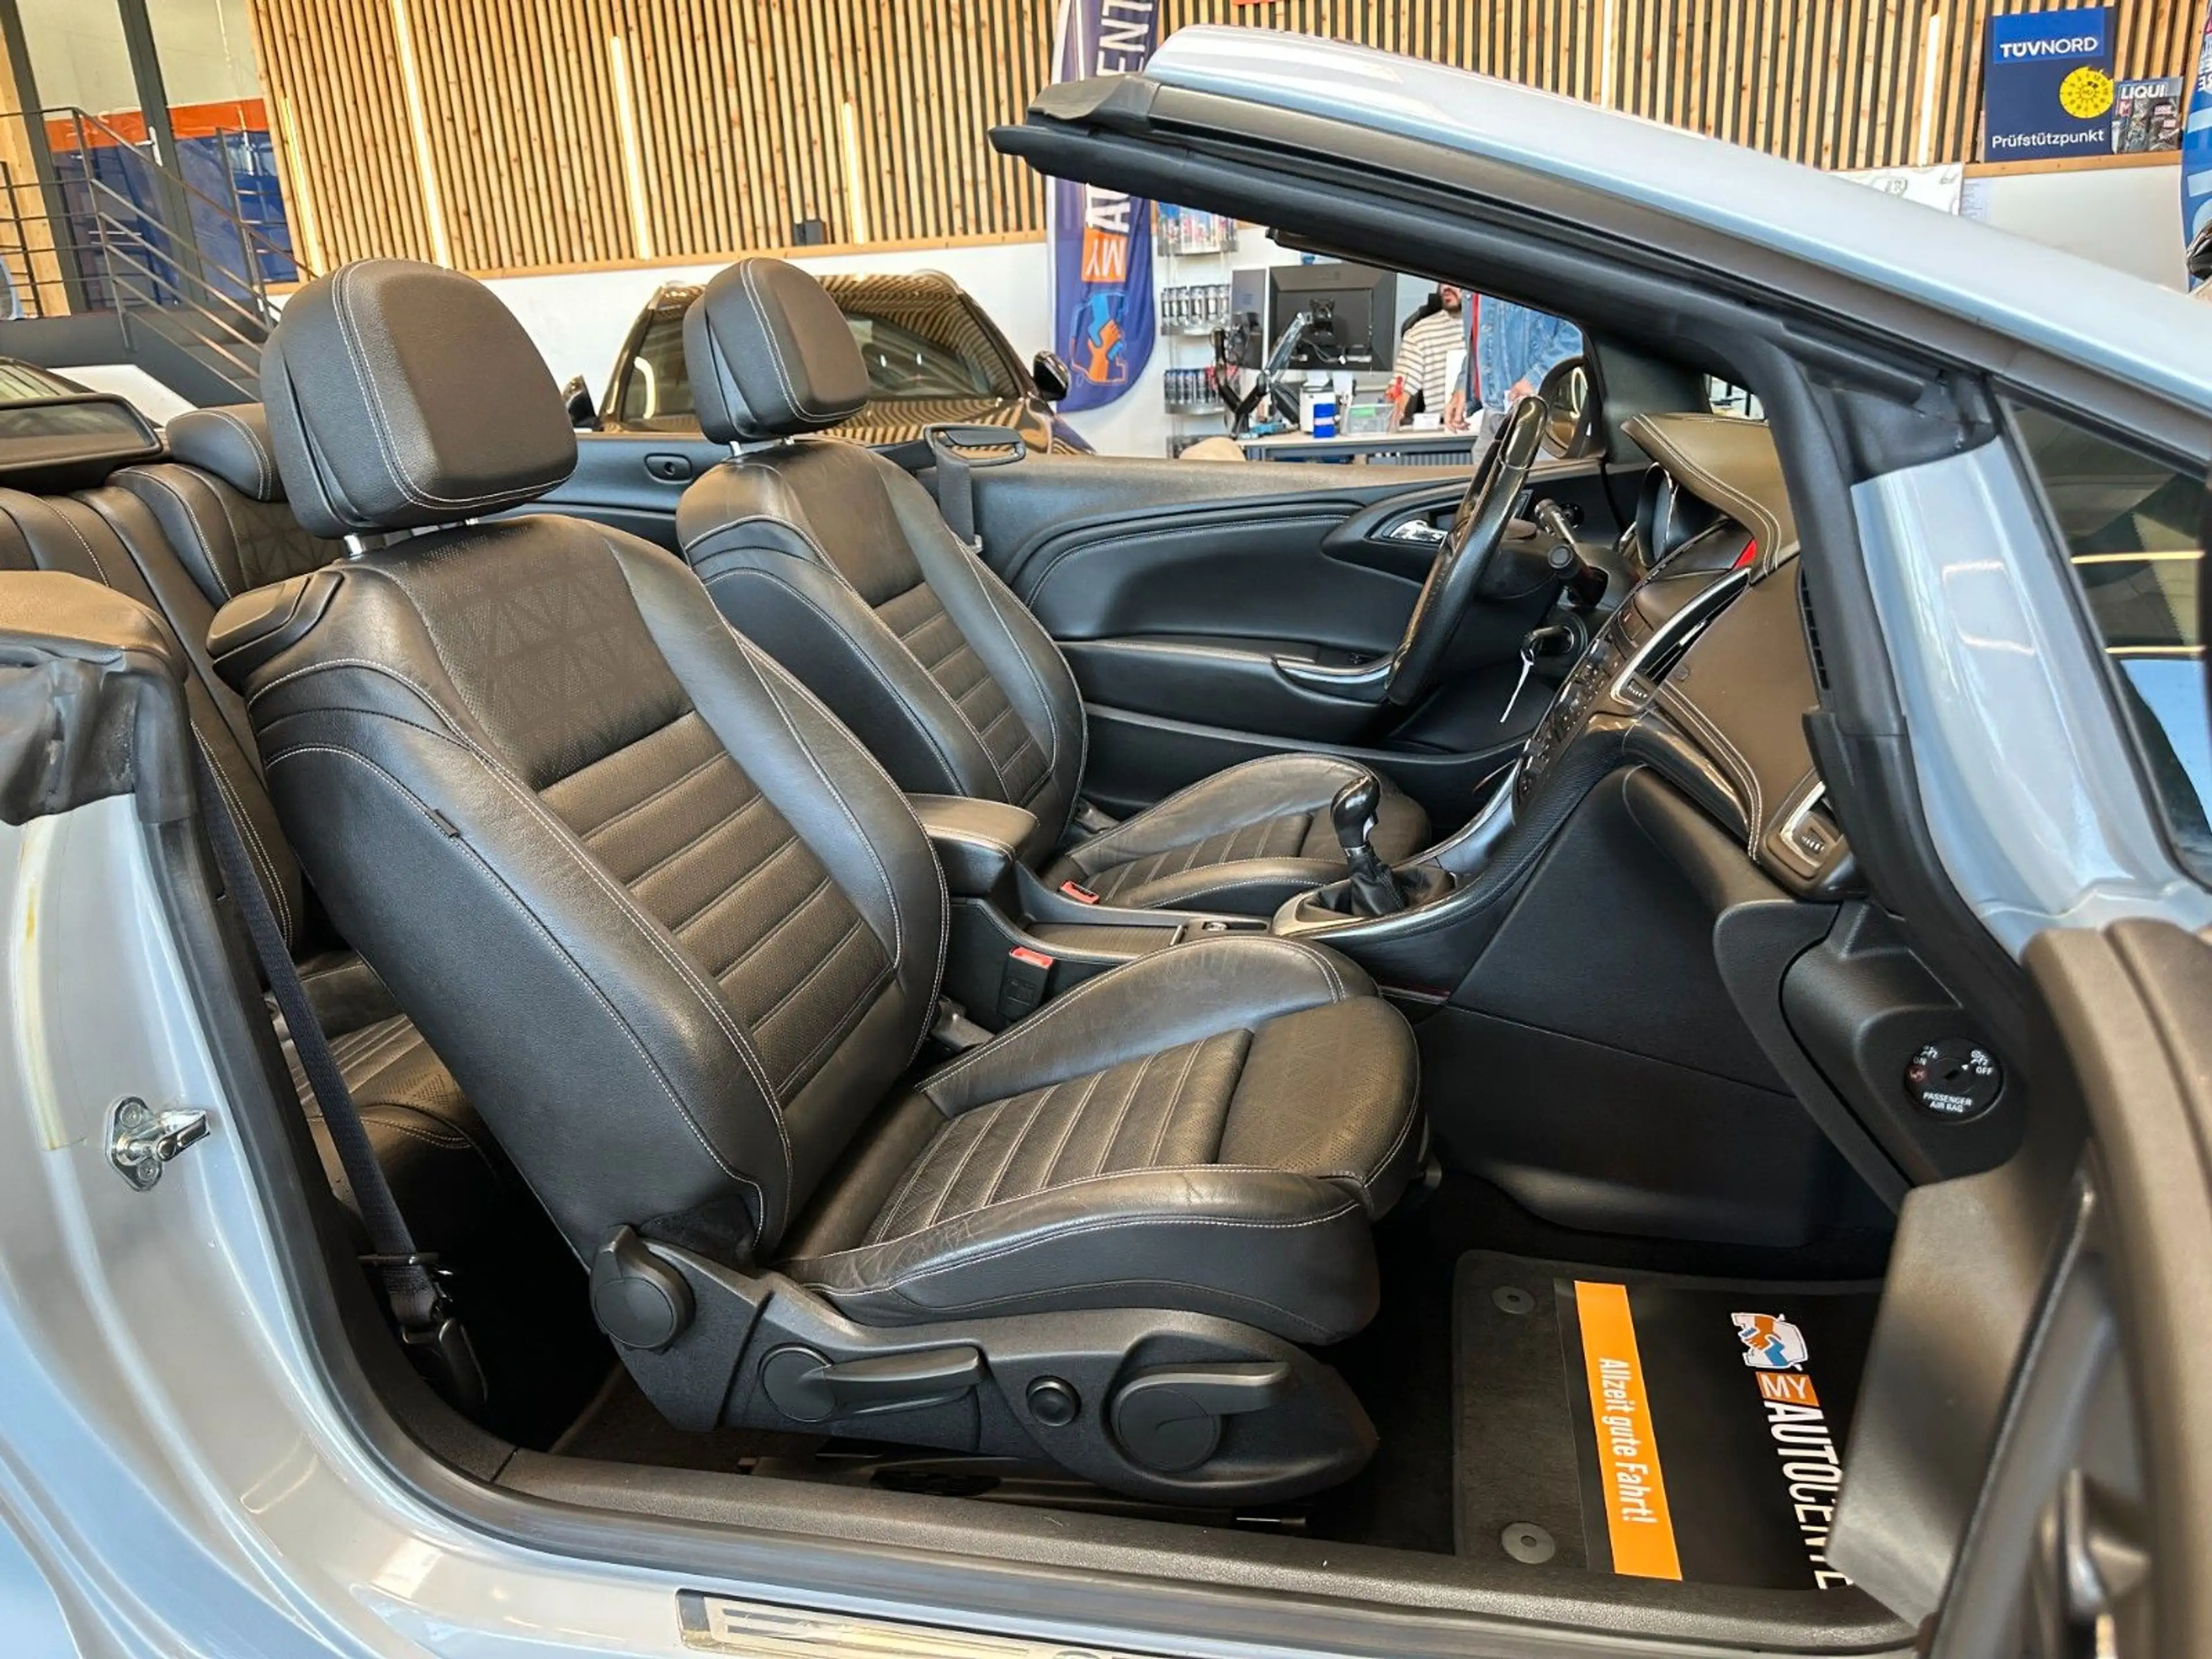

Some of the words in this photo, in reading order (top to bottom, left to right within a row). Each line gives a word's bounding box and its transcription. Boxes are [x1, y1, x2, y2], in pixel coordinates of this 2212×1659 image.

[2121, 84, 2165, 99] LIQUI
[1992, 129, 2104, 149] Prüfstützpunkt
[1086, 237, 1127, 278] MY
[1976, 1066, 1993, 1076] OFF
[1923, 1092, 1973, 1107] PASSENGER
[1930, 1101, 1945, 1109] AIR
[1946, 1103, 1963, 1113] BAG
[1599, 1357, 1637, 1413] Allzeit
[1763, 1373, 1808, 1400] MY
[1601, 1415, 1642, 1457] gute
[1615, 1461, 1659, 1523] Fahrt!
